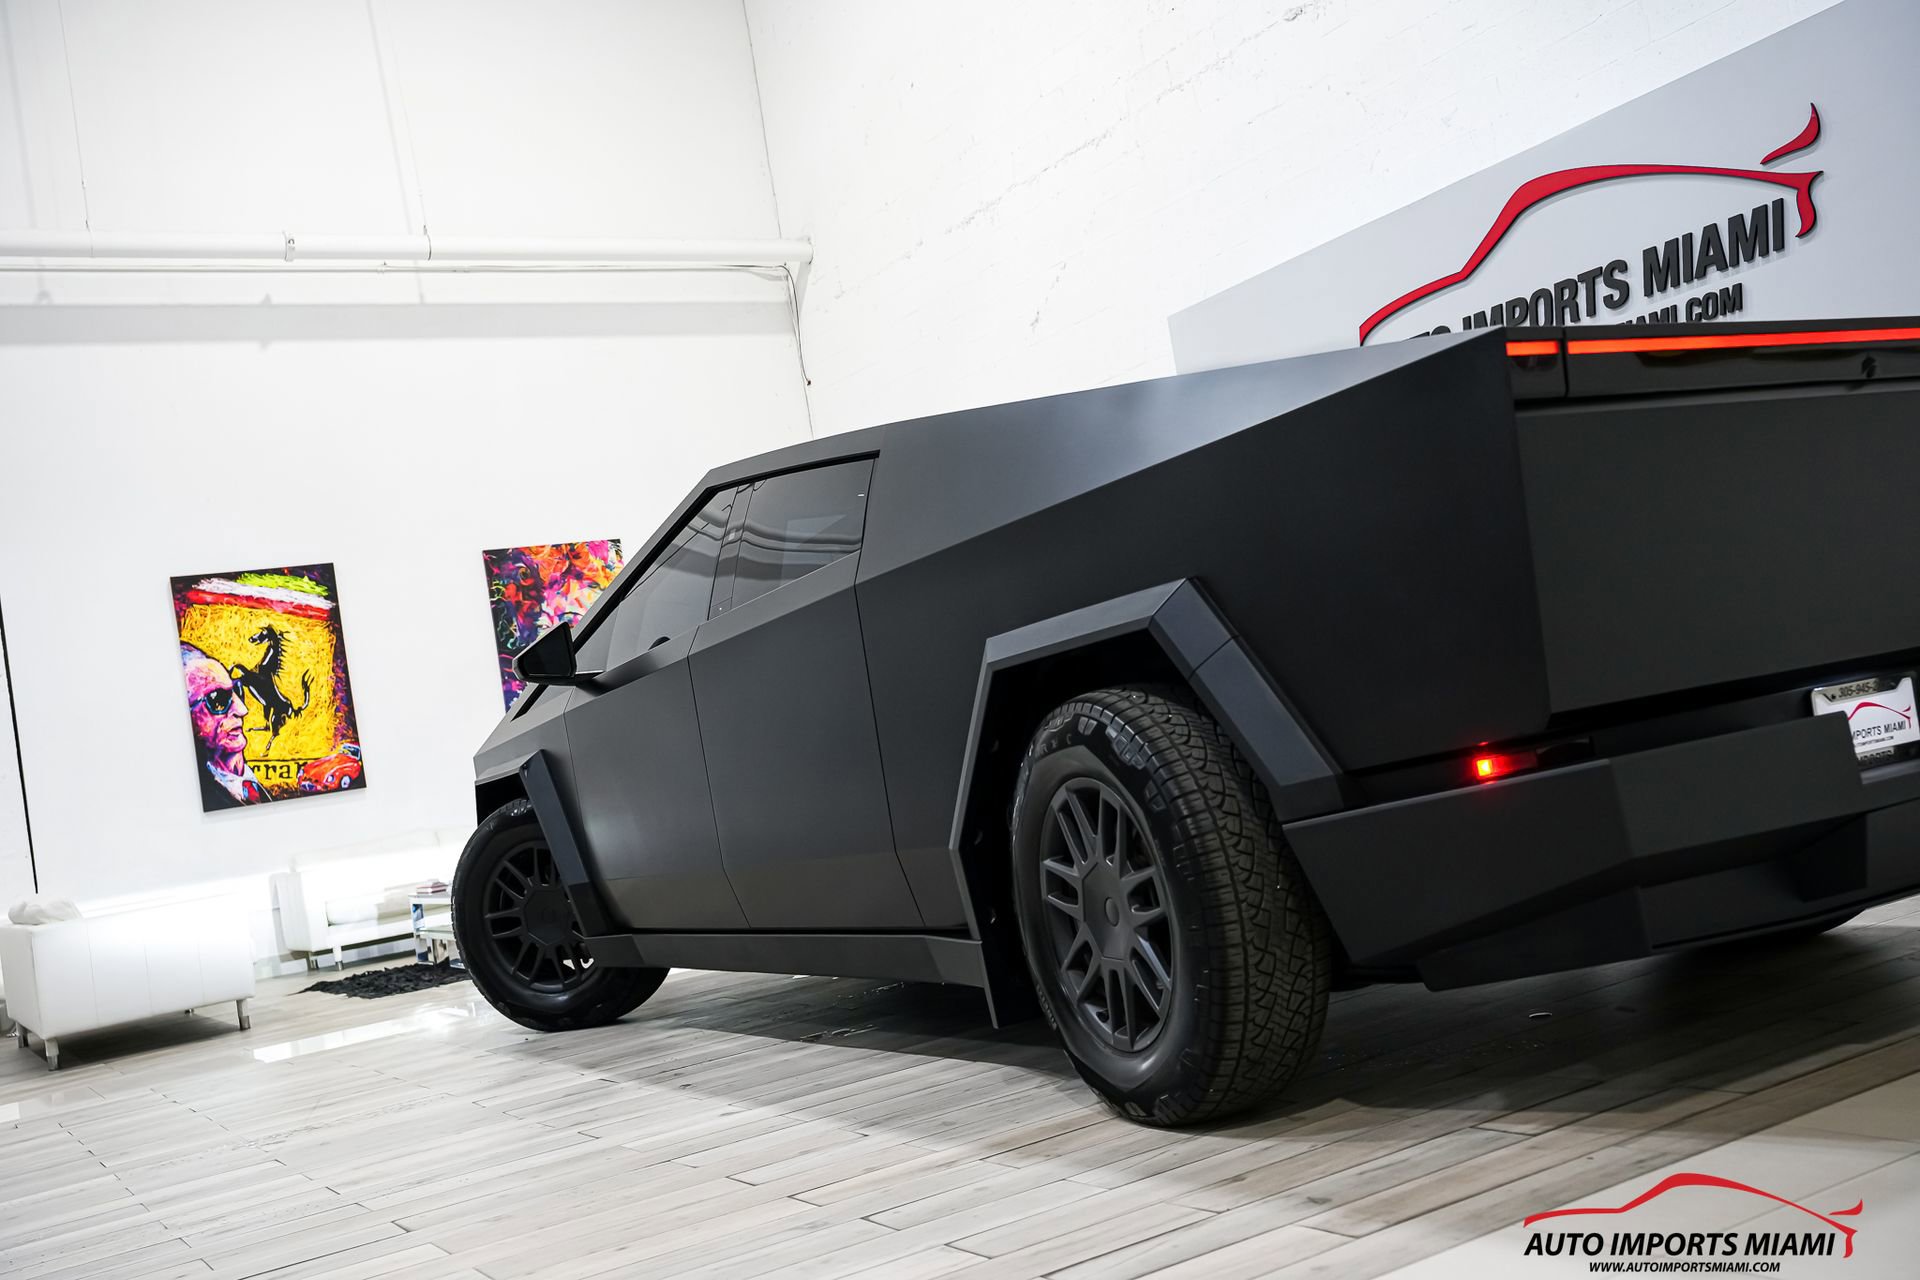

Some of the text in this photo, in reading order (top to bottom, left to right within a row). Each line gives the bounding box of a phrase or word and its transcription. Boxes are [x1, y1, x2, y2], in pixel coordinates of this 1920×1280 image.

[1462, 198, 1785, 330] PORTS MIAMI
[1884, 720, 1906, 734] MIAMI
